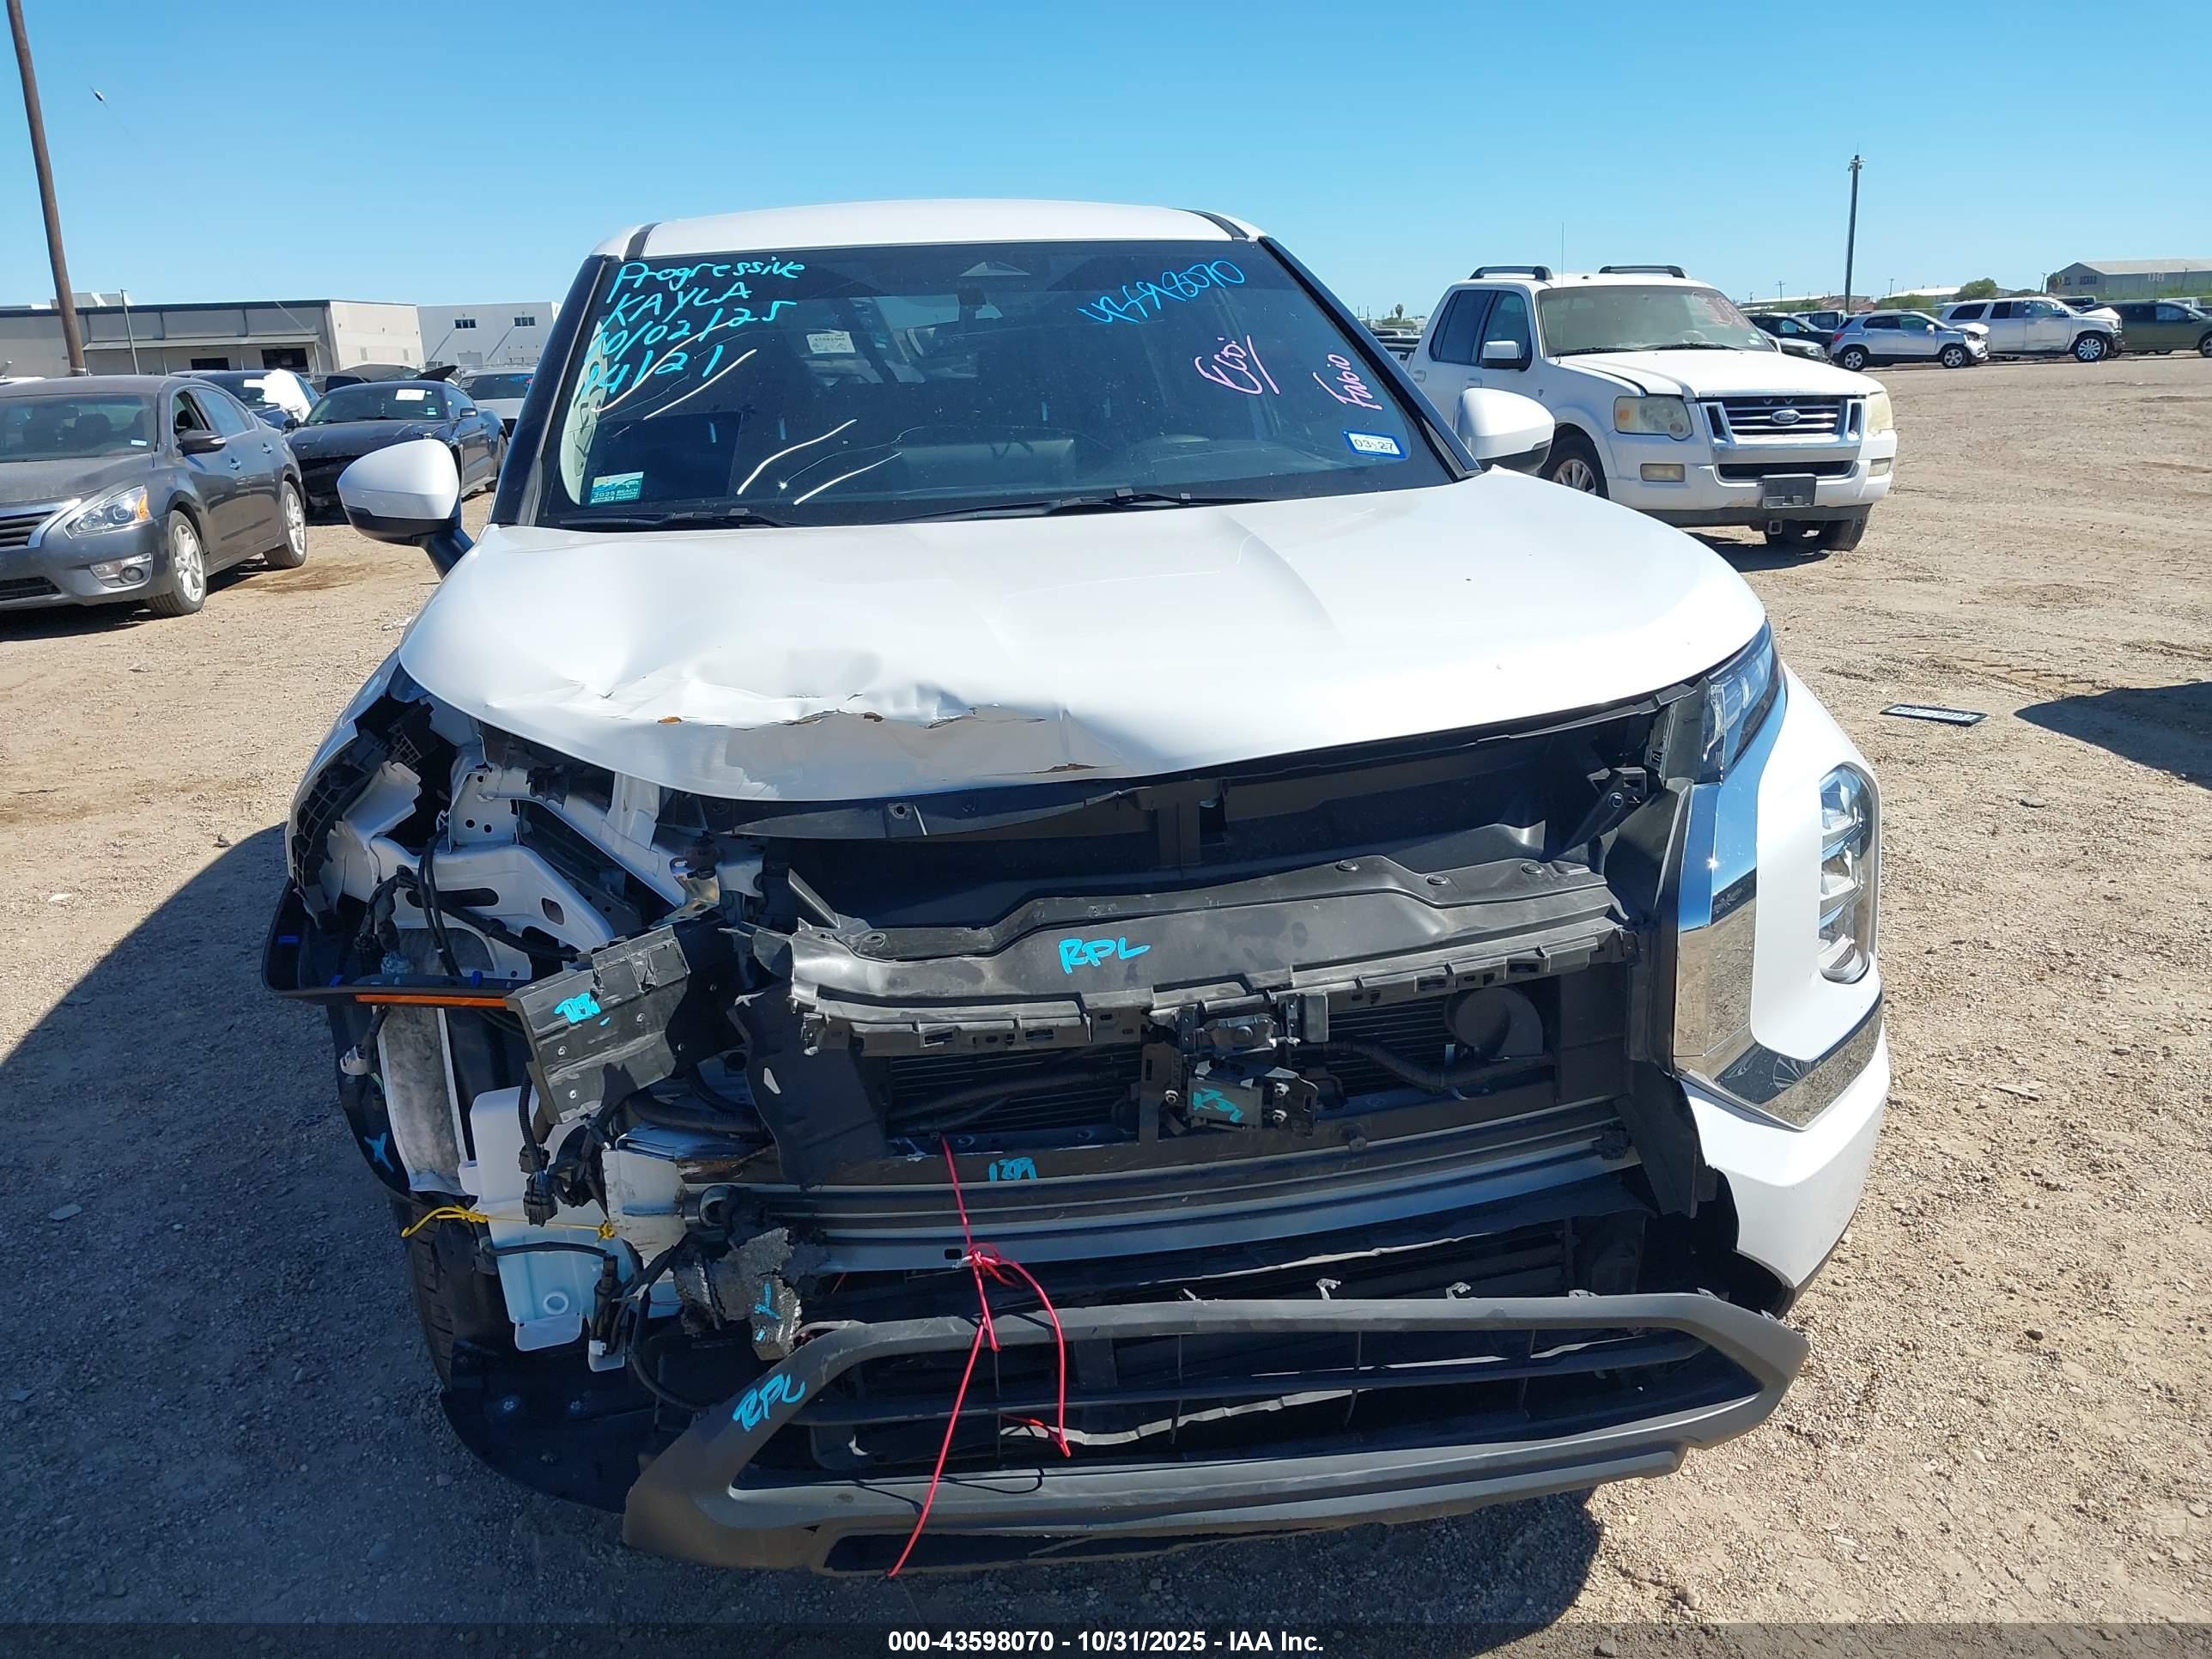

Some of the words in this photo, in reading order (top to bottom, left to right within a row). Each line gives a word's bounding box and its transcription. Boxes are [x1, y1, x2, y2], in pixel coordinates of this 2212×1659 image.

[605, 256, 805, 304] Progressive
[600, 282, 752, 332] KAYLA
[1354, 439, 1372, 448] 03
[1377, 441, 1394, 451] 27
[1057, 934, 1151, 975] RPL
[732, 1372, 807, 1432] RPL
